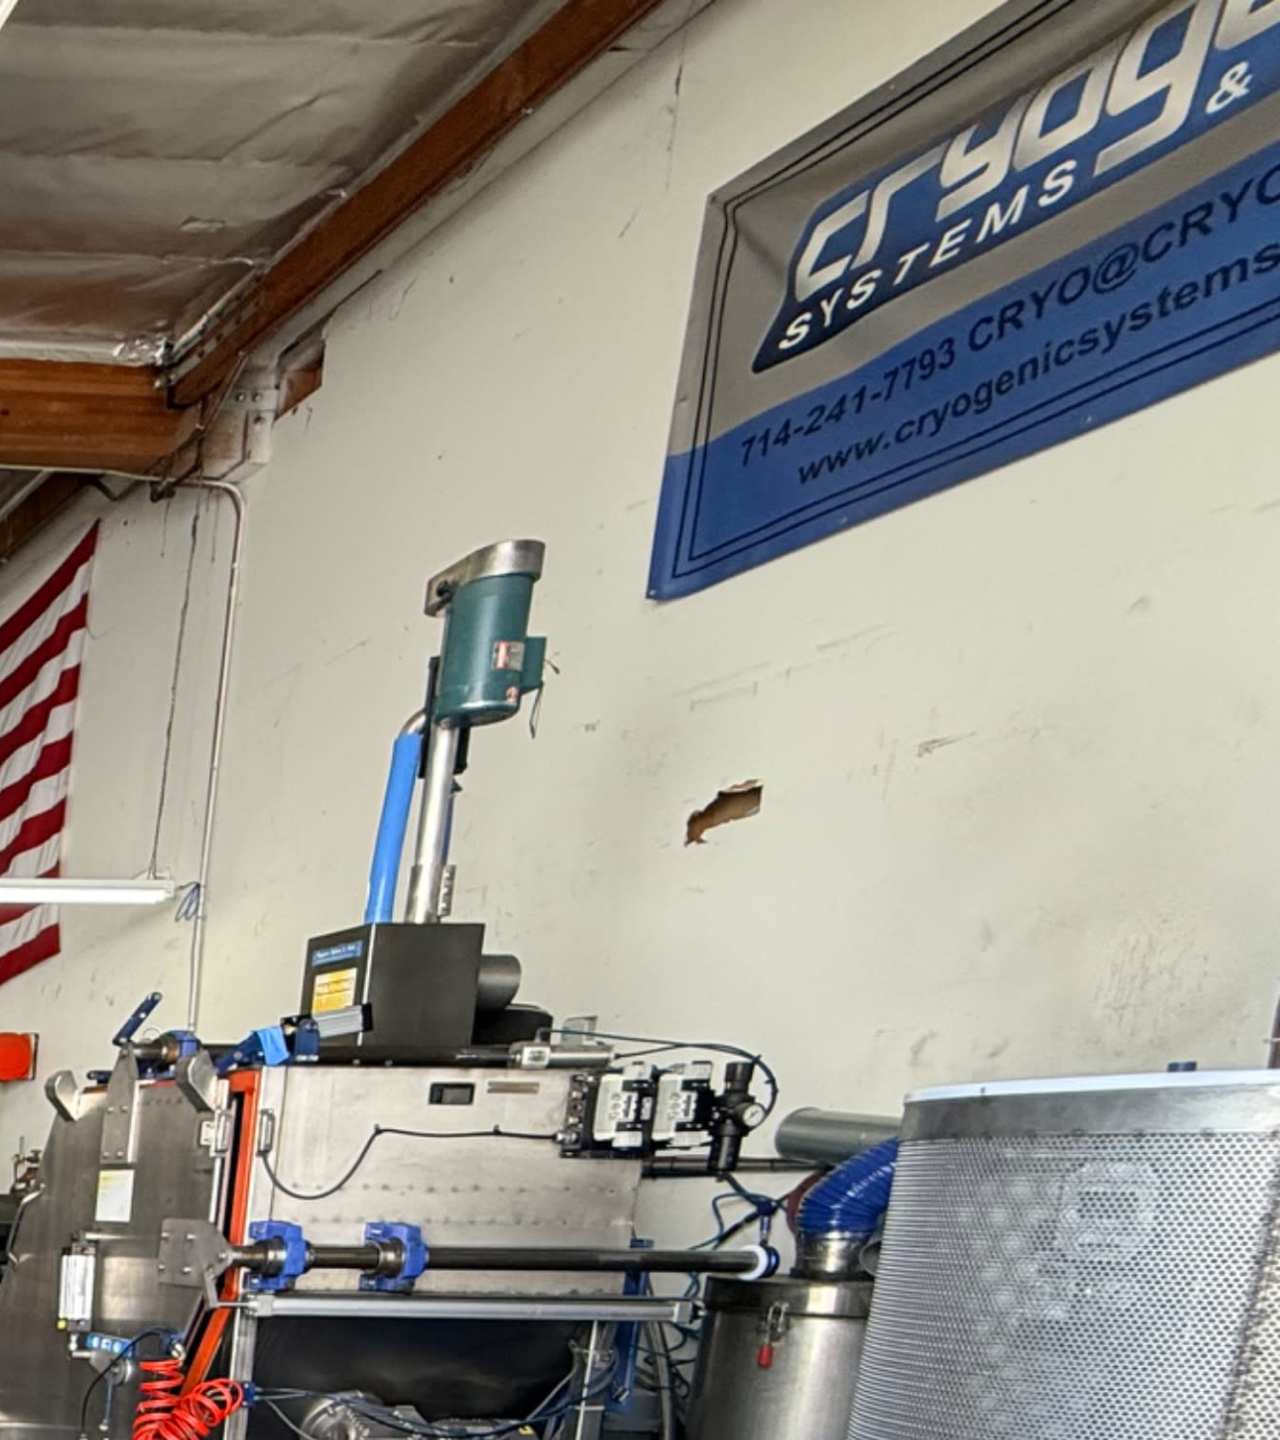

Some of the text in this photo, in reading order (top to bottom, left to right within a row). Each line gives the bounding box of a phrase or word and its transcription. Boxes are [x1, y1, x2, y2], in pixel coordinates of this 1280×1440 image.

[778, 61, 1253, 350] SYSTEMS &
[742, 336, 956, 467] 714-241-7793
[798, 243, 1280, 485] www.cryogenicsystems
